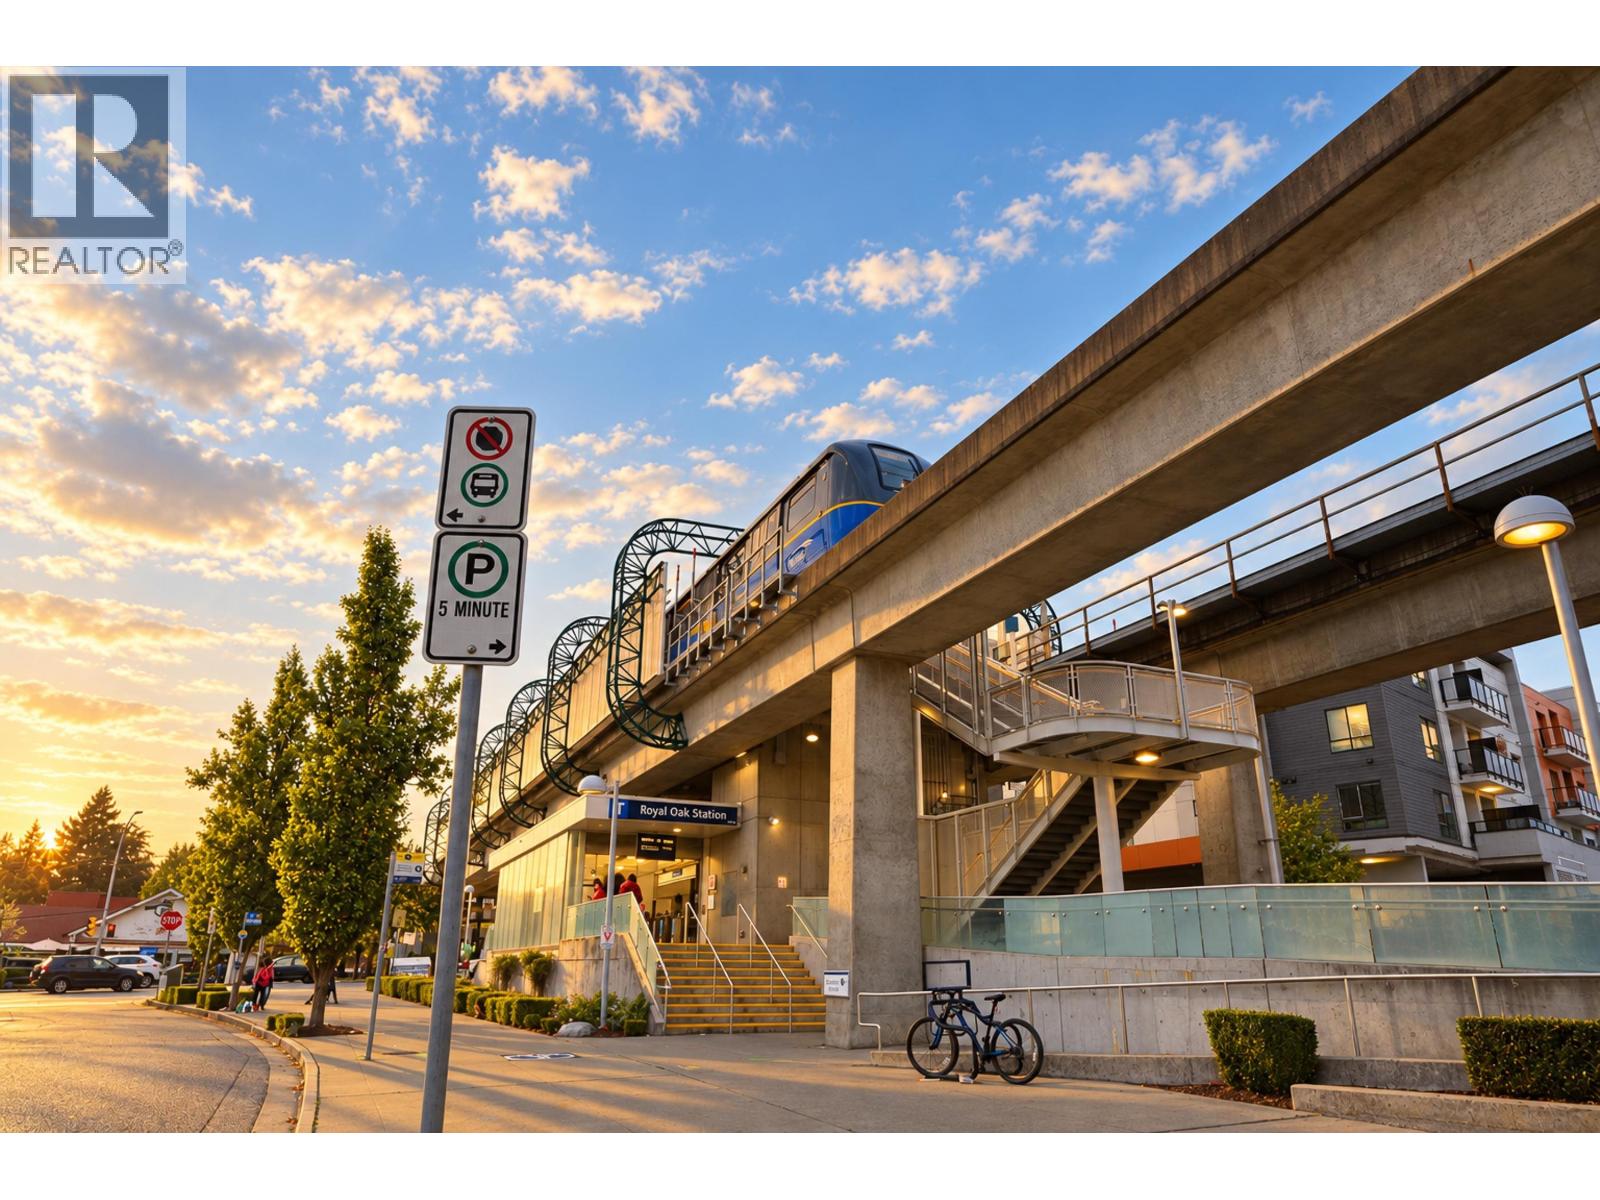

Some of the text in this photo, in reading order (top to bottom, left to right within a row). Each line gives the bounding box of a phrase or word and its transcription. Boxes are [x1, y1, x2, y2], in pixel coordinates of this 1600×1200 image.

[465, 553, 495, 585] P
[438, 600, 510, 618] 5 MINUTE
[640, 804, 668, 819] Royal
[670, 807, 690, 818] Oak
[692, 808, 727, 820] Station
[161, 916, 181, 925] STOP
